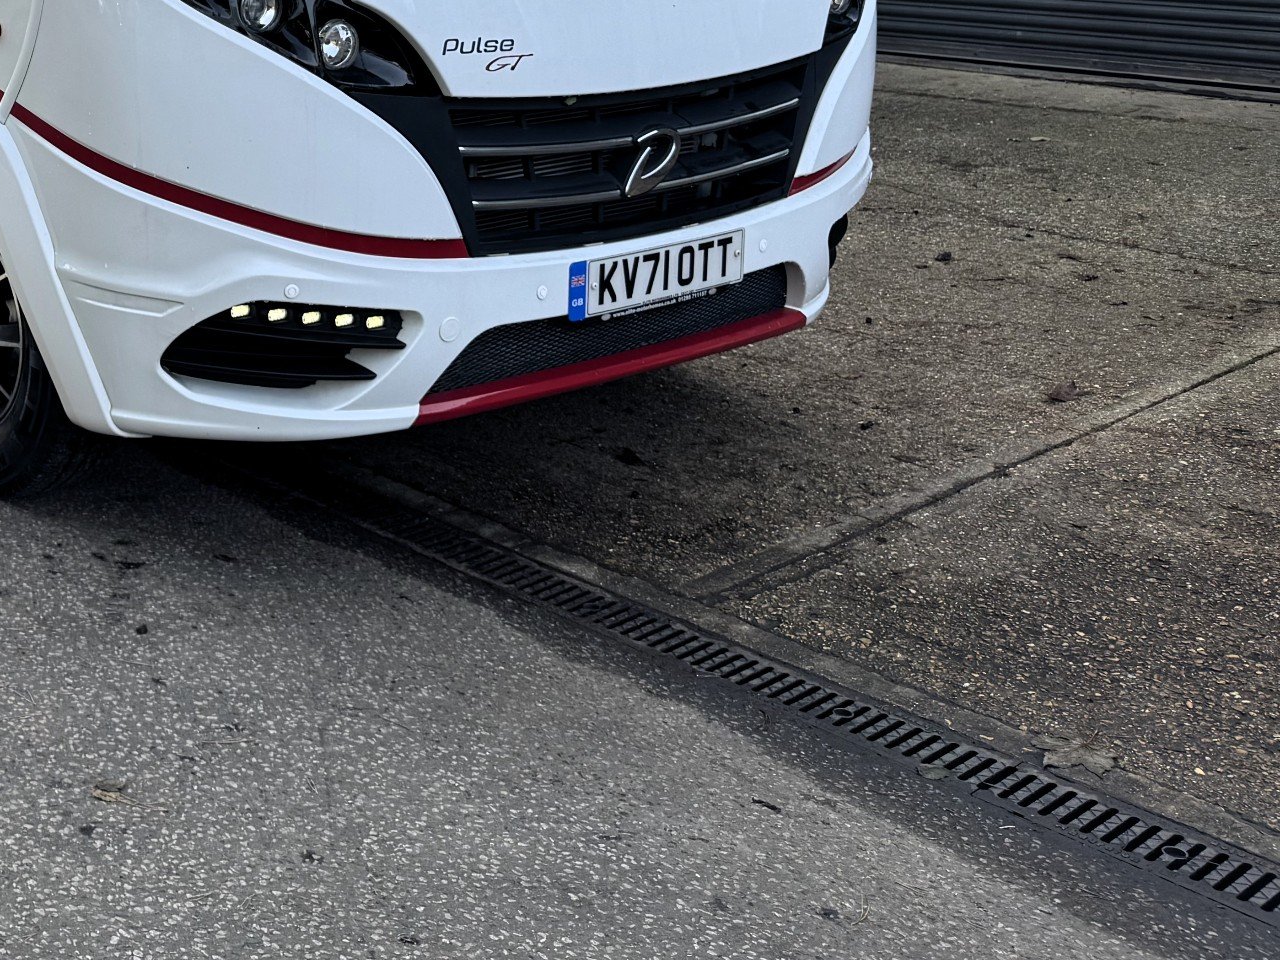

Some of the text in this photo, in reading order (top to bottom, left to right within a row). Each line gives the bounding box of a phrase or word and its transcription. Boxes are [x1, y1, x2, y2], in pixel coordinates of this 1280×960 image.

[442, 36, 515, 56] Pulse
[485, 53, 534, 72] GT
[571, 298, 584, 307] GB
